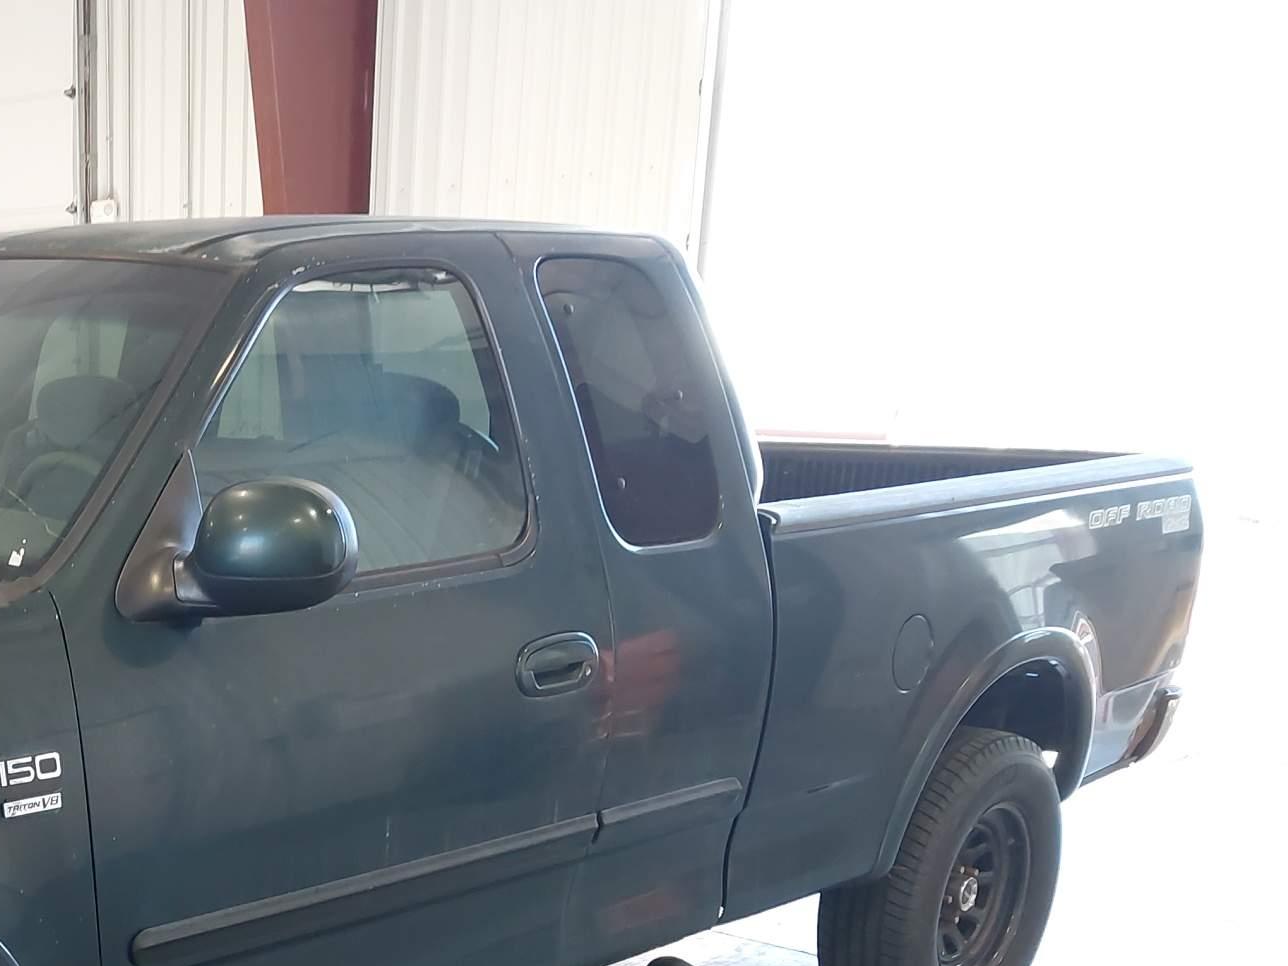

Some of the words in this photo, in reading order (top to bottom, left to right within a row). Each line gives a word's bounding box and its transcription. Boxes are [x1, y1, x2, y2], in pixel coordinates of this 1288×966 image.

[1088, 504, 1131, 530] OFF
[6, 800, 41, 816] TRITON
[41, 795, 60, 810] V8
